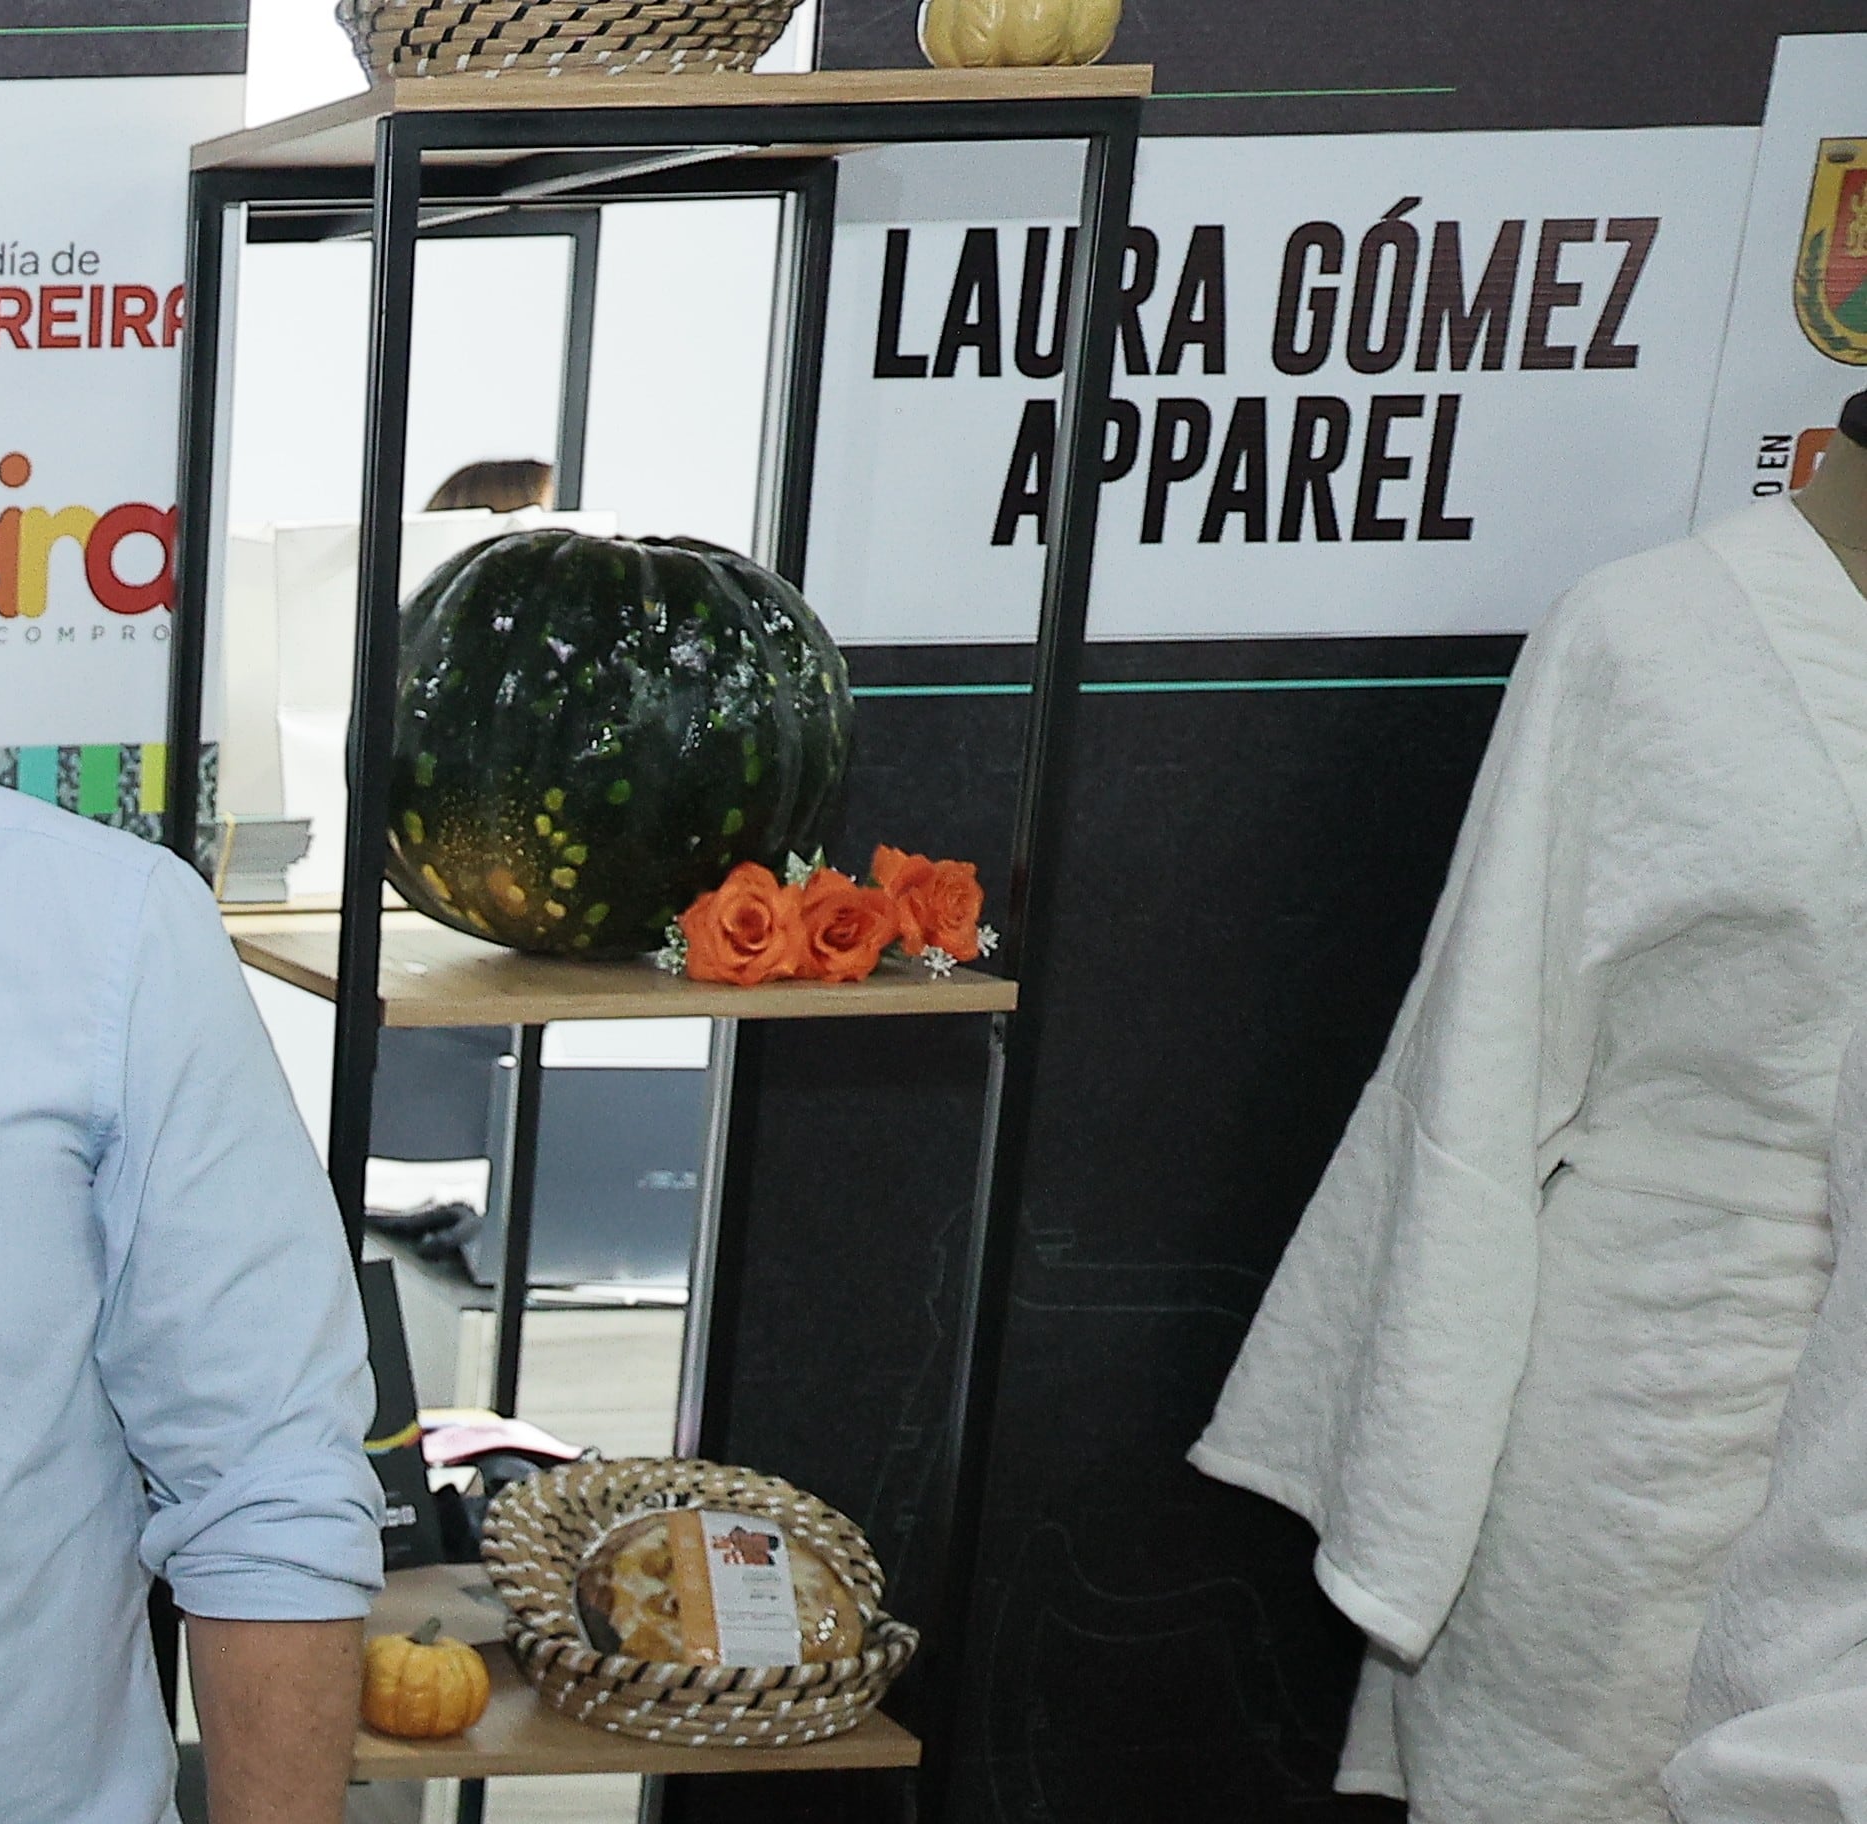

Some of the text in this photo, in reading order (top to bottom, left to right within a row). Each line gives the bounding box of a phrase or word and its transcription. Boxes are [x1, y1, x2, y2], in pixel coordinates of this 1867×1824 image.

[51, 243, 101, 276] de
[872, 196, 1661, 379] LAURA GÓMEZ
[990, 393, 1474, 546] APPAREL
[1757, 435, 1793, 469] EN
